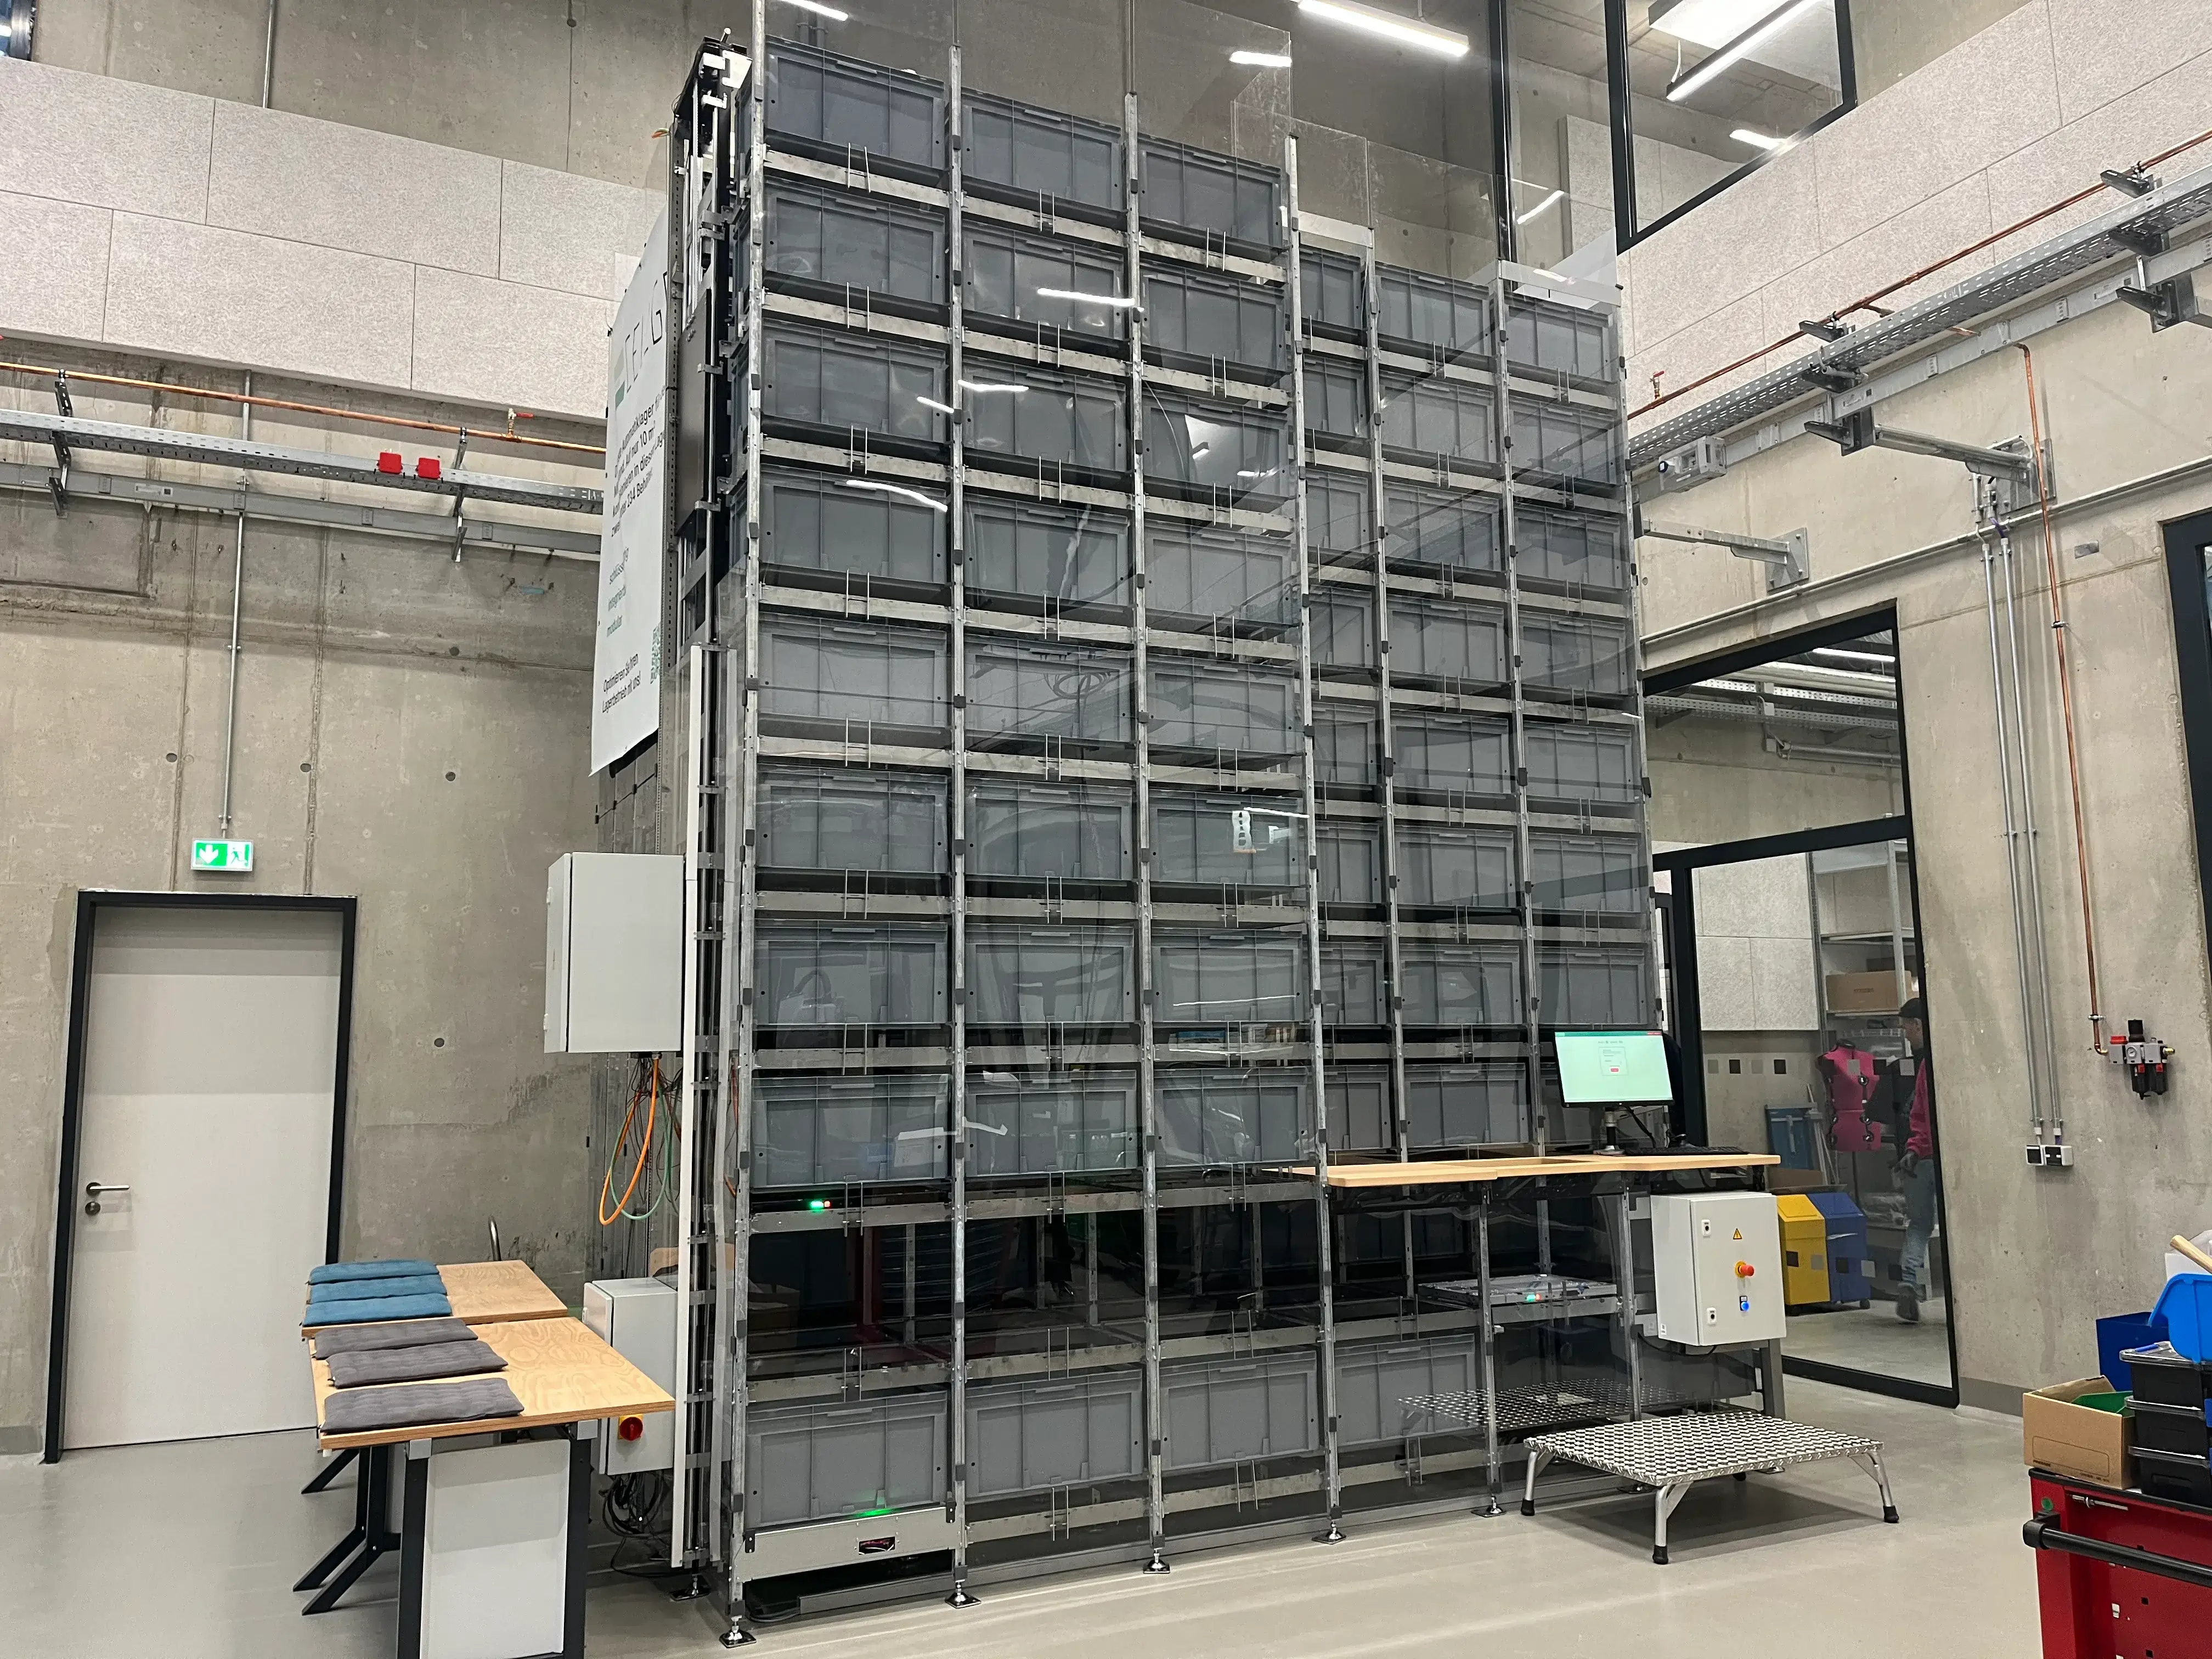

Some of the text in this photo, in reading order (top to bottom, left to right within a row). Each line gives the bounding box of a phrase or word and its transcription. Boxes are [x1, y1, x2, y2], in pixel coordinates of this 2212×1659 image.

[640, 431, 647, 447] 10
[634, 463, 639, 477] in
[602, 684, 627, 713] Lagerbetrieb
